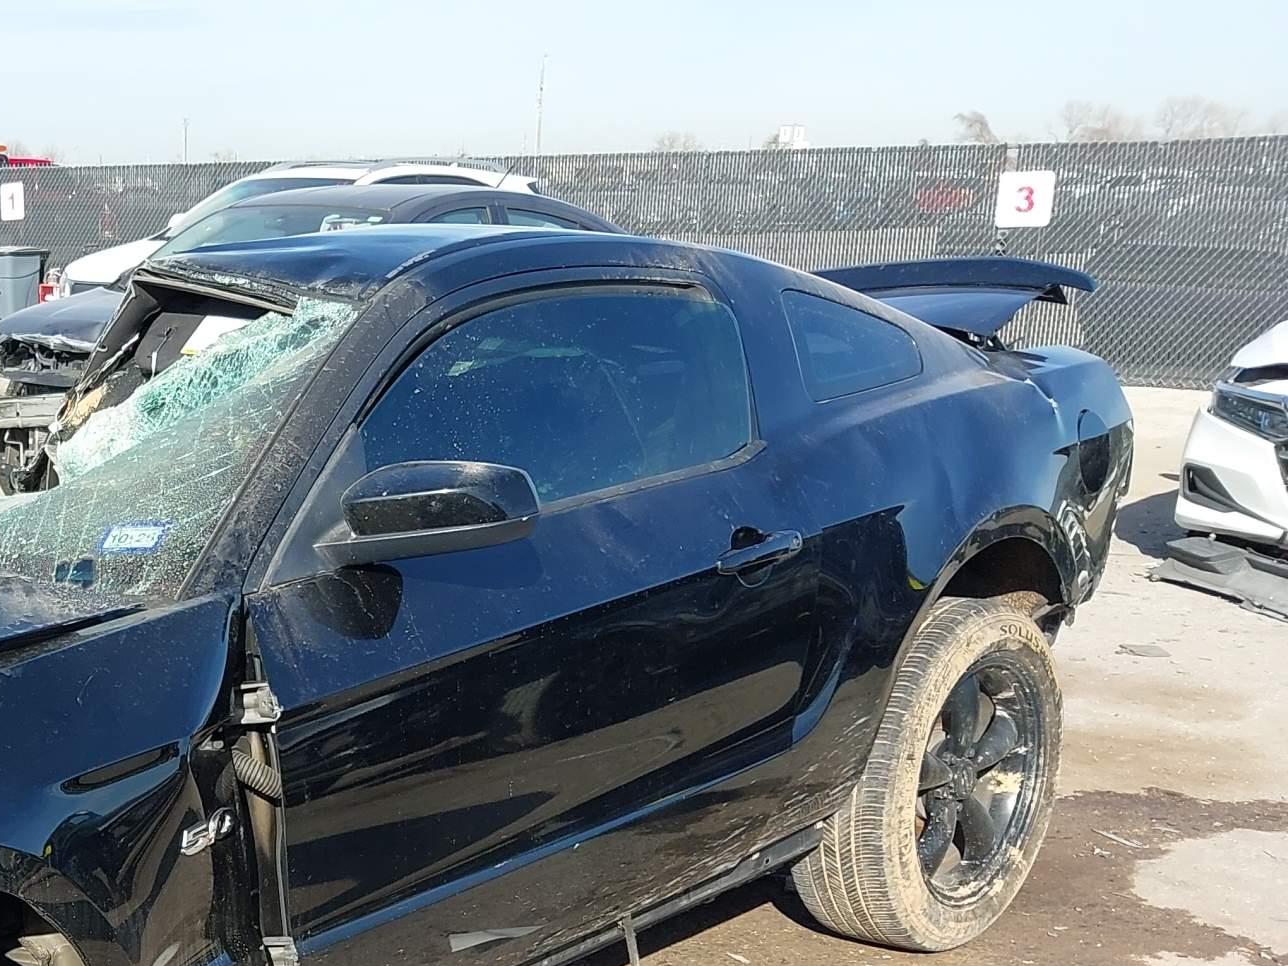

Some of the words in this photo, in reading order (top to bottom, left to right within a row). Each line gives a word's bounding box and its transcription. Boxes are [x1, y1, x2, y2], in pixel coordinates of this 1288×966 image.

[8, 192, 16, 211] 1
[1015, 185, 1035, 213] 3
[999, 623, 1041, 648] SOLUS
